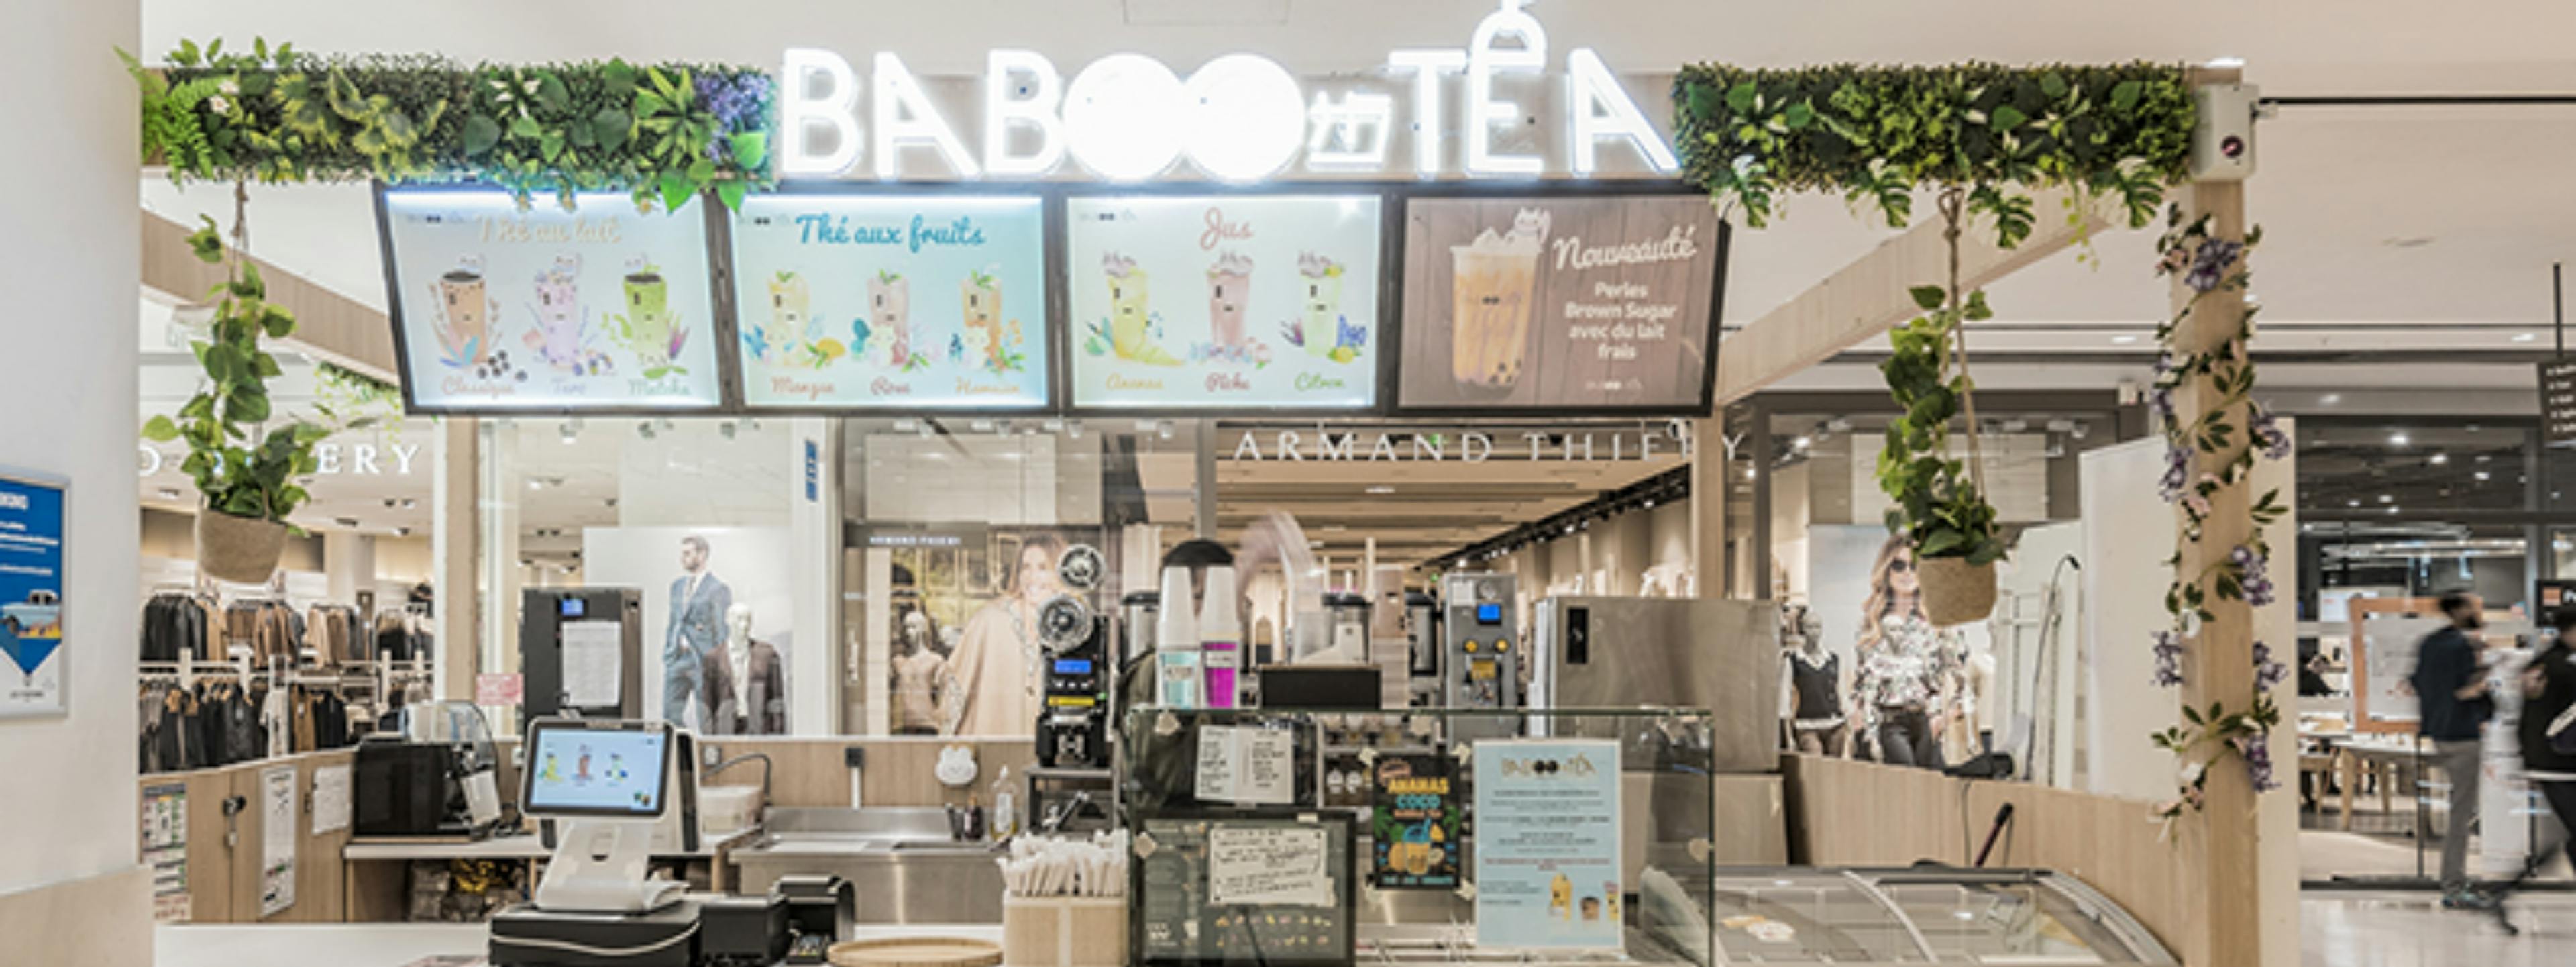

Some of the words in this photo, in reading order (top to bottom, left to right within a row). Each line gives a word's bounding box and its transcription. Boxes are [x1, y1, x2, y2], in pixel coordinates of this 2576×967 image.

[796, 213, 851, 244] Thé
[854, 224, 903, 244] aux
[908, 214, 987, 254] fruits
[1199, 207, 1254, 250] Jus
[1553, 224, 1697, 270] Nouveauté
[1595, 281, 1648, 298] Perles
[1565, 301, 1622, 319] Brown
[1624, 301, 1677, 322] Sugar
[1569, 325, 1608, 339] avec
[1611, 321, 1635, 340] du
[1637, 322, 1665, 340] lait
[1598, 342, 1637, 360] frais
[1233, 430, 1491, 462] ARMAND
